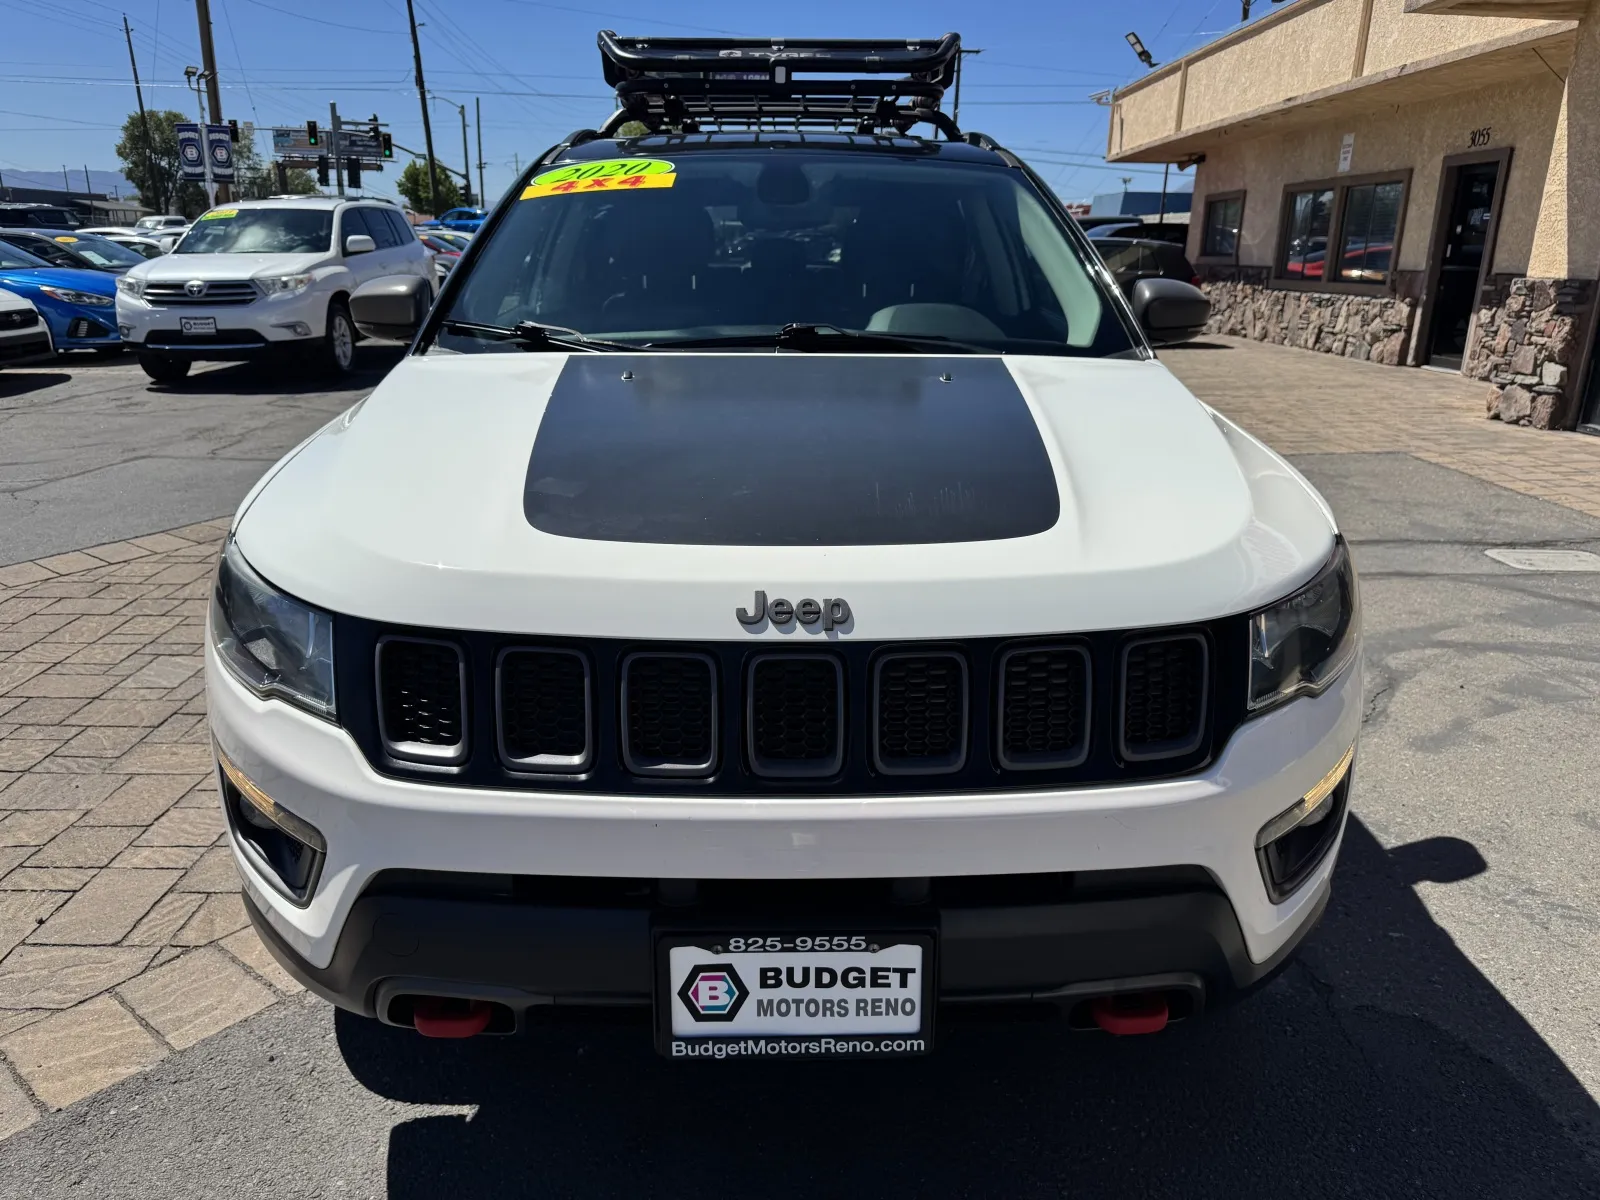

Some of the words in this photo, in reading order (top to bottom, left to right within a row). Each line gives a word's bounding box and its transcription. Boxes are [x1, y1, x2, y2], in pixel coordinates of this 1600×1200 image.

[1467, 127, 1492, 148] 3055
[554, 162, 652, 181] 2020
[736, 590, 850, 631] Jeep
[728, 936, 867, 952] 825-9555
[759, 966, 917, 989] BUDGET
[697, 980, 731, 1006] B
[756, 998, 850, 1018] MOTORS
[855, 997, 917, 1017] RENO
[671, 1038, 926, 1059] BudgetMotorsReno.com
